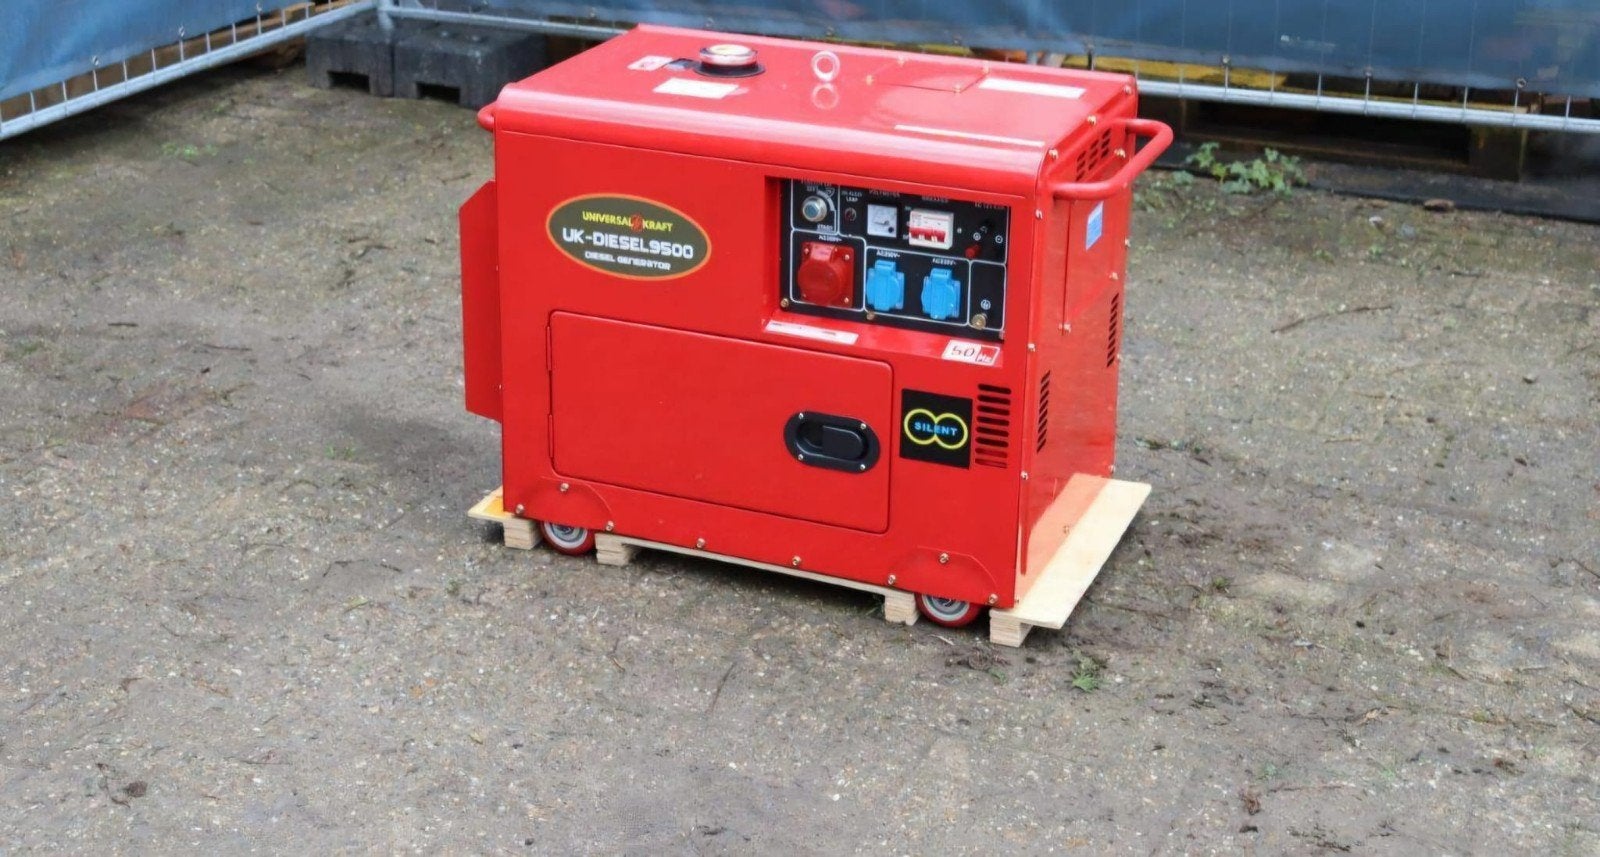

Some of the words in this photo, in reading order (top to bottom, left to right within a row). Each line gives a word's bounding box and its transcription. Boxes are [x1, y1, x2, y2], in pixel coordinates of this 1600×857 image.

[582, 211, 633, 227] UNIVERSAL
[643, 219, 674, 232] KRAFT
[584, 250, 616, 263] DIESEL
[616, 256, 672, 271] GENERATOR
[951, 345, 976, 358] 50
[913, 421, 958, 436] SILENT
